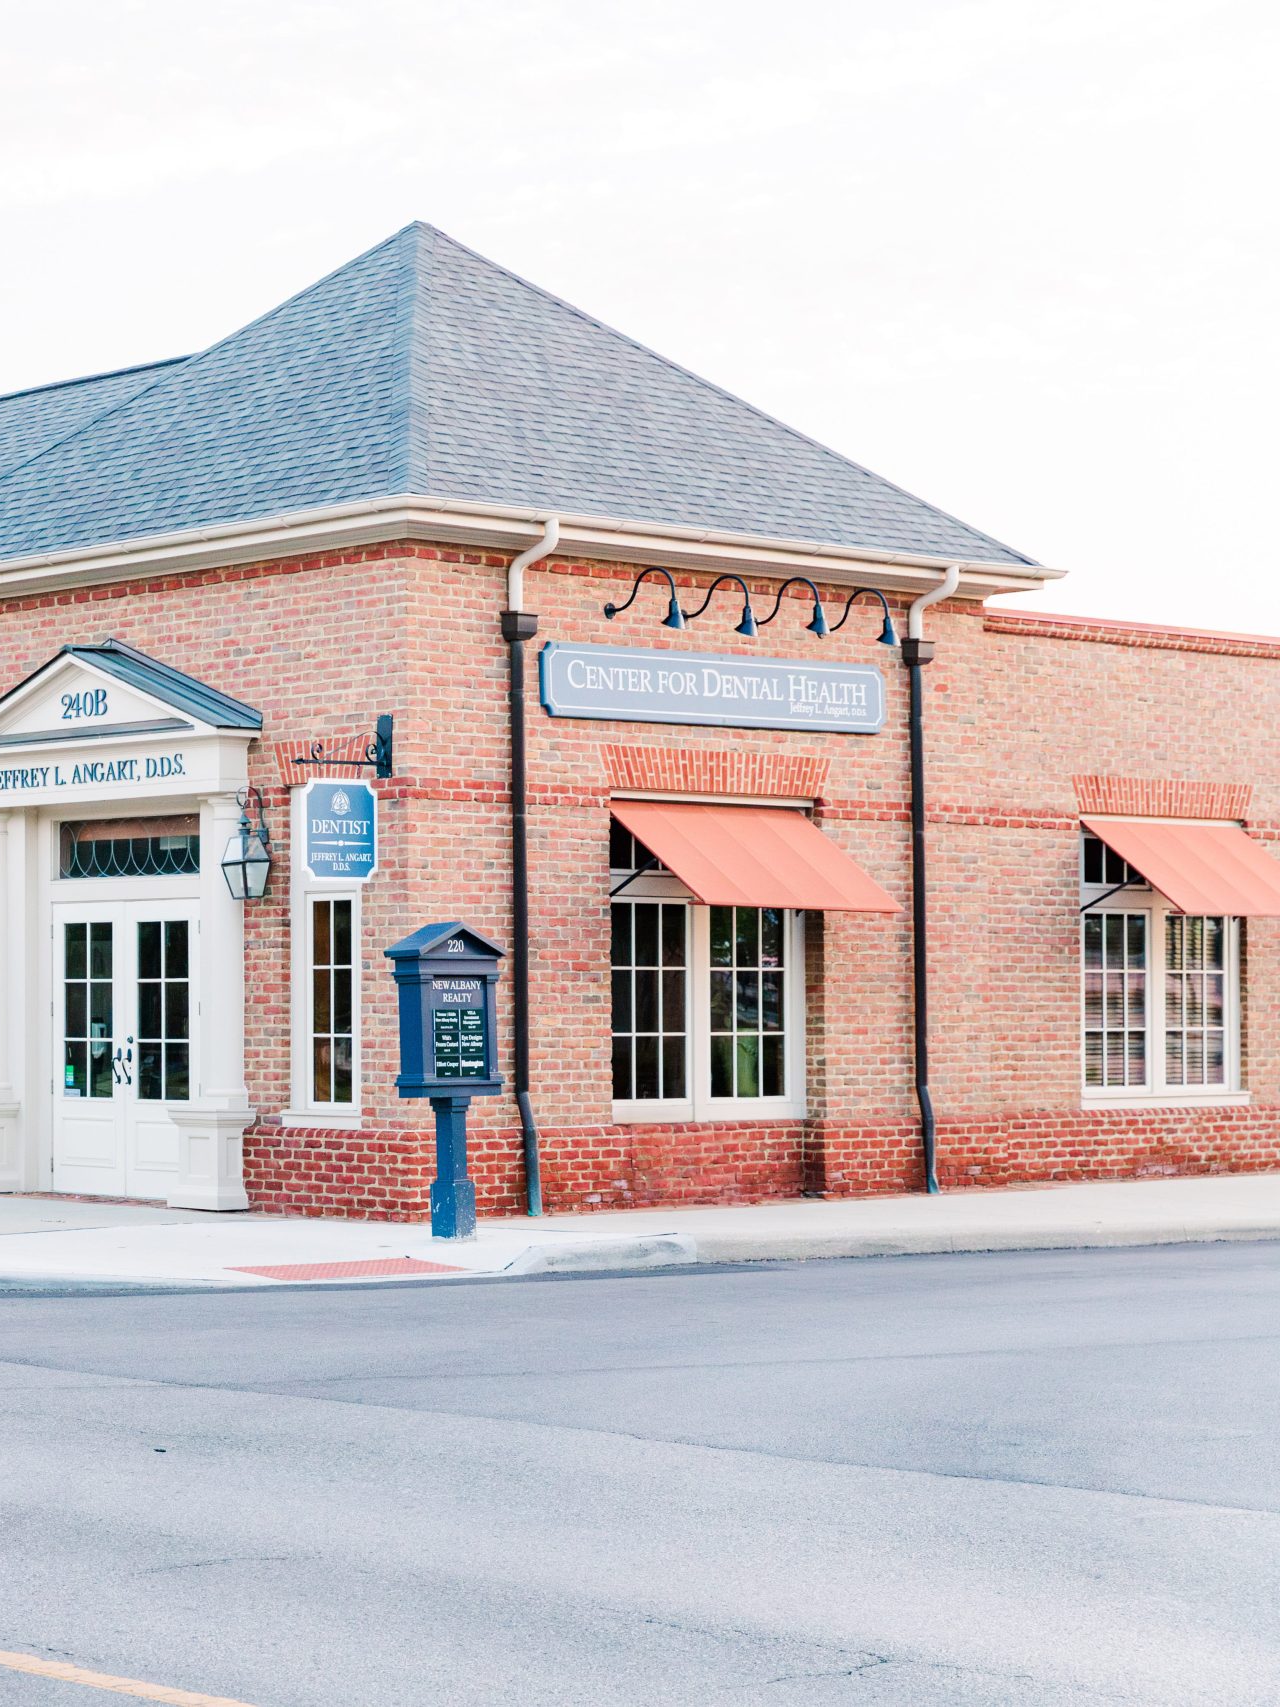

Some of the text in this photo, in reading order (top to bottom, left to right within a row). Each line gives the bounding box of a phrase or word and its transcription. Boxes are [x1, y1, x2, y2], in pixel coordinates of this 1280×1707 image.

[567, 659, 868, 706] CENTER FOR DENTAL HEALTH
[61, 689, 108, 720] 240B
[789, 702, 815, 718] Jeffrey
[55, 766, 67, 785] L.
[72, 759, 141, 785] ANGART,
[146, 753, 186, 778] D.D.S.
[311, 819, 371, 835] DENTIST
[310, 852, 338, 863] JEFFREY
[345, 853, 372, 863] ANGART,
[447, 939, 464, 953] 220
[432, 980, 481, 990] NEW ALBANY
[442, 992, 472, 1003] REALTY
